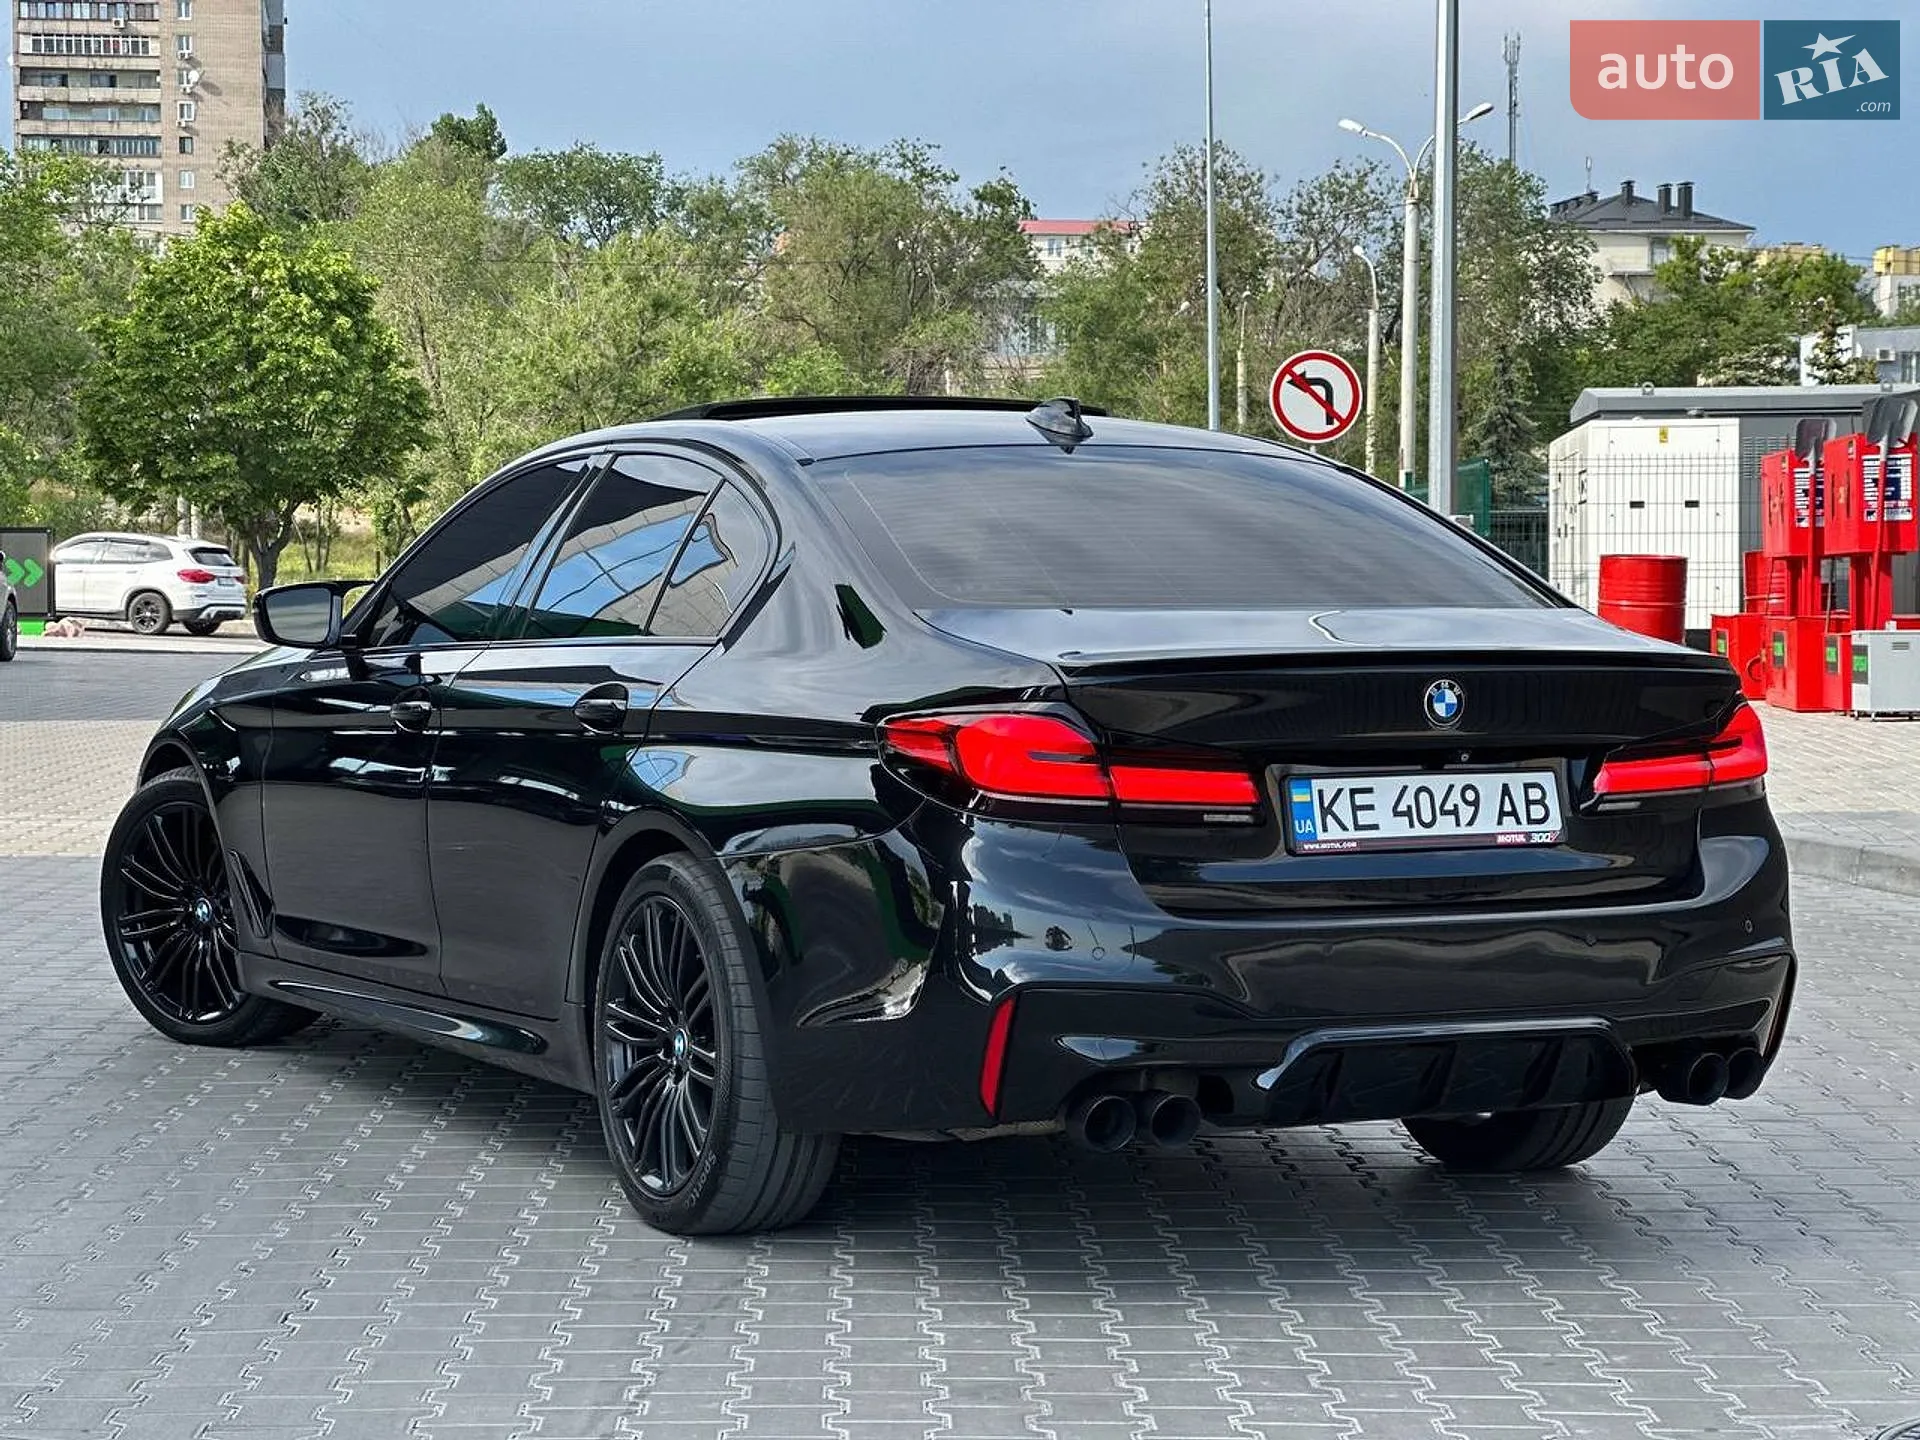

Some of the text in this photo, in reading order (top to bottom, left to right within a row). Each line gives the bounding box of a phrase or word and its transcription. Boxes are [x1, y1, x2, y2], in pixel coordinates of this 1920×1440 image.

[1317, 781, 1550, 833] KE 4049 AB
[1295, 820, 1315, 834] UA
